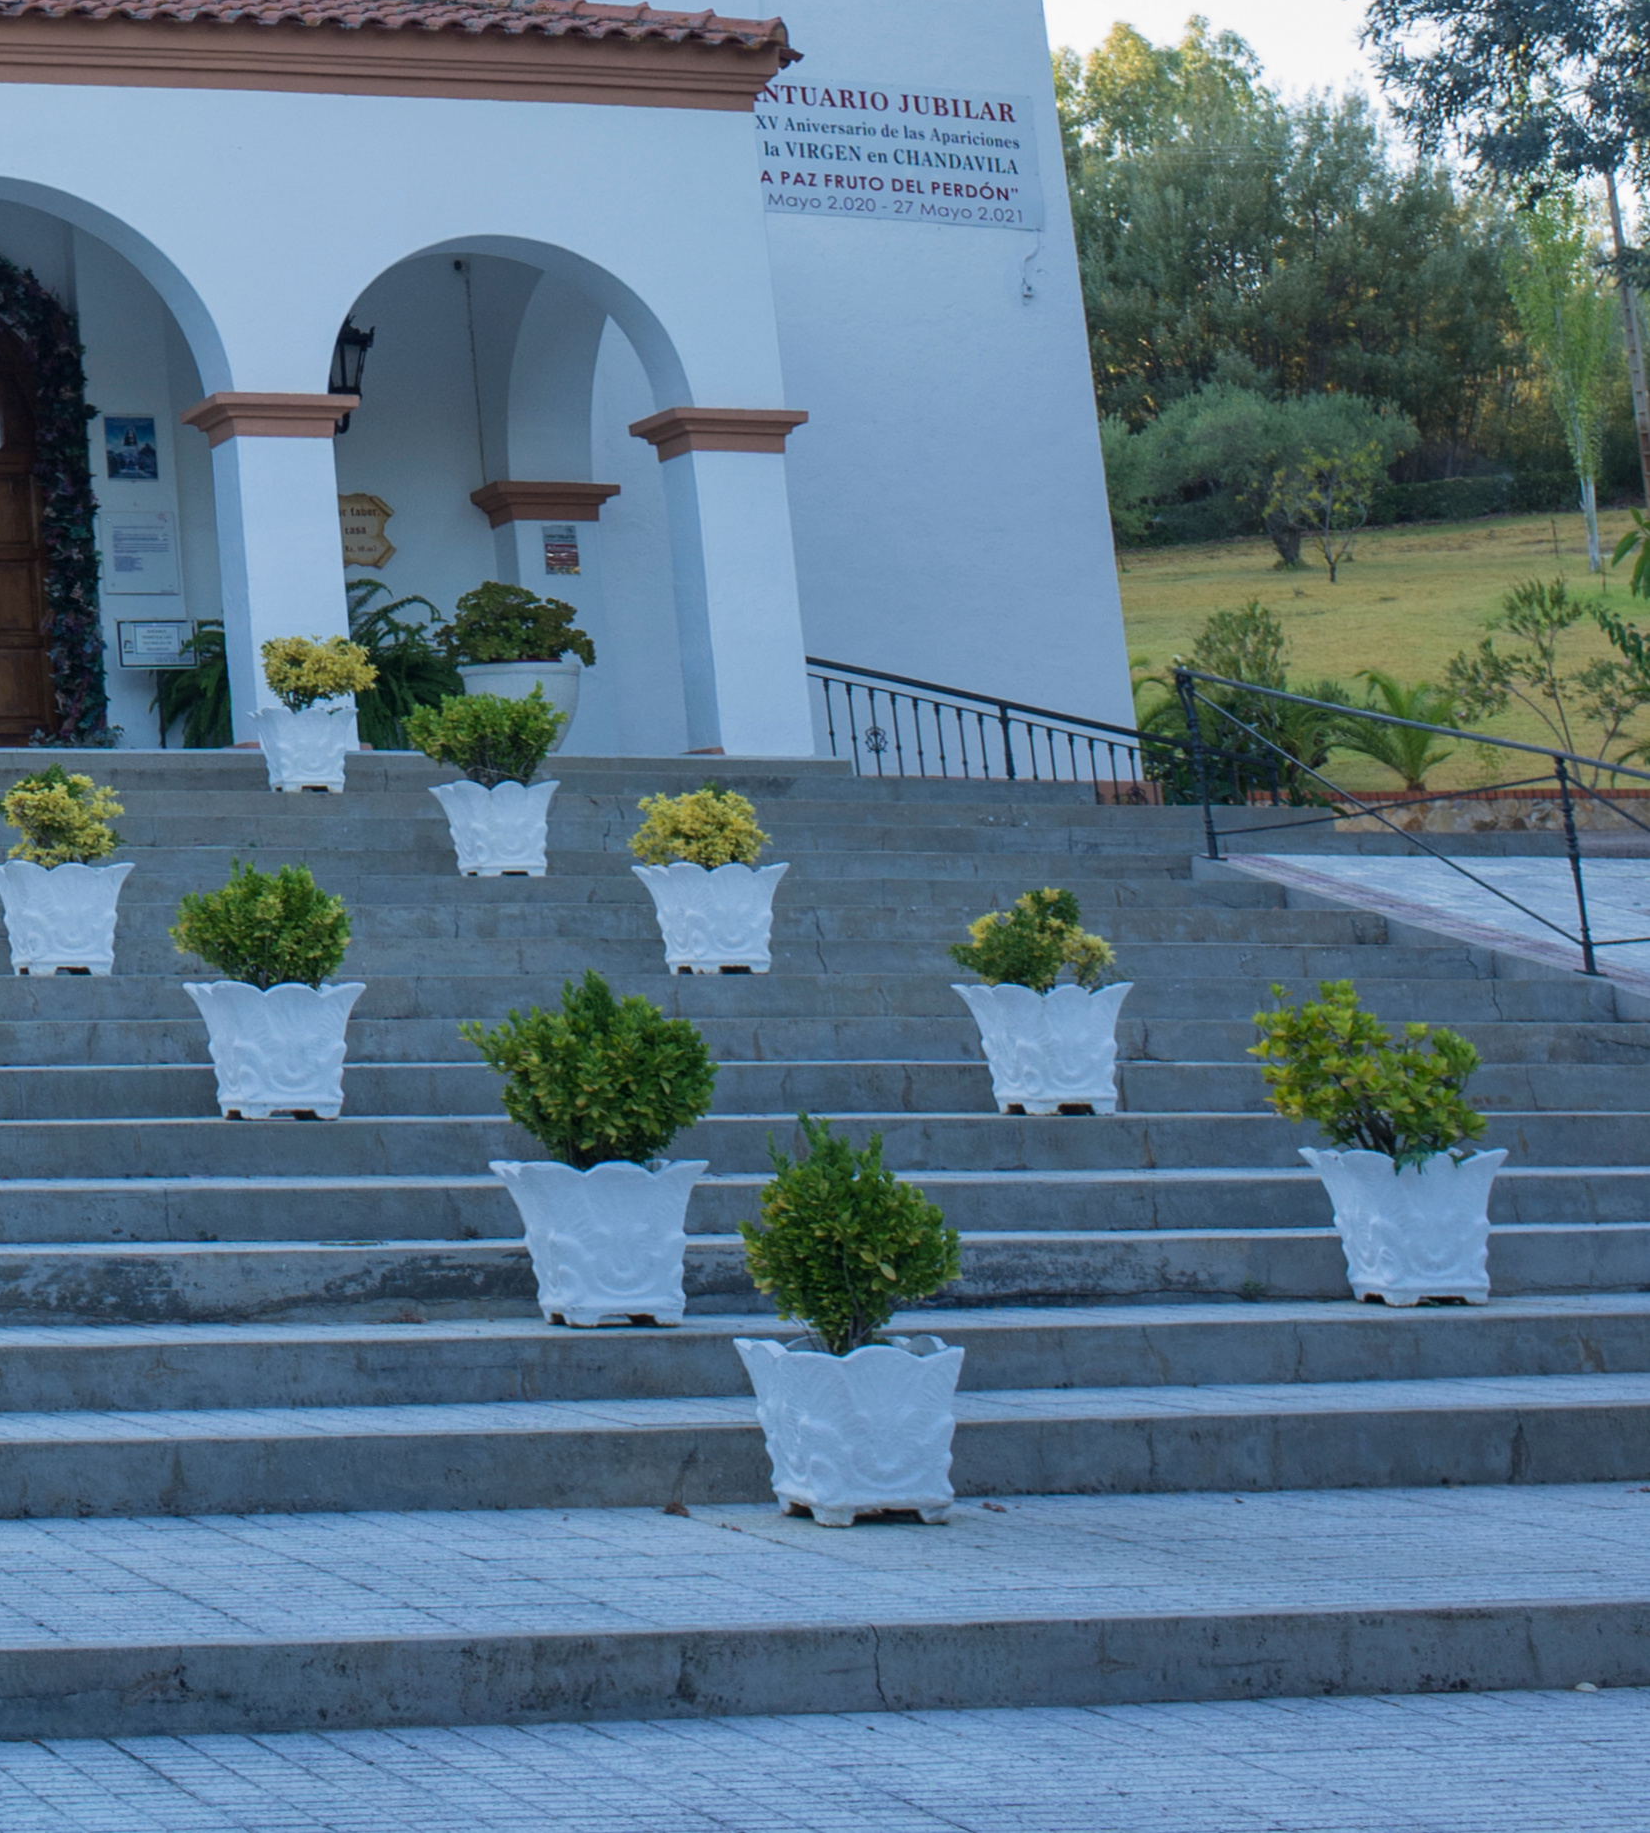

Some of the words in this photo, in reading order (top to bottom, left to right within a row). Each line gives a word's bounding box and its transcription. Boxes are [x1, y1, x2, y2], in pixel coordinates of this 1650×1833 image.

[754, 84, 889, 111] NTUARIO
[898, 93, 1017, 123] JUBILAR
[755, 114, 779, 130] XV
[784, 116, 877, 137] Aniversario
[881, 123, 899, 138] de
[903, 124, 926, 141] las
[930, 127, 1021, 150] Apariciones
[763, 140, 780, 157] la
[784, 140, 862, 162] VIRGEN
[867, 150, 888, 164] en
[893, 148, 1020, 175] CHANDAVILA
[760, 169, 774, 184] A
[781, 171, 818, 187] PAZ
[824, 173, 885, 191] FRUTO
[891, 177, 925, 195] DEL
[931, 180, 1019, 202] PERDÓN"
[767, 192, 822, 211] Mayo
[827, 195, 877, 213] 2.020
[894, 199, 914, 215] 27
[920, 202, 973, 222] Mayo
[977, 206, 1024, 224] 2.021
